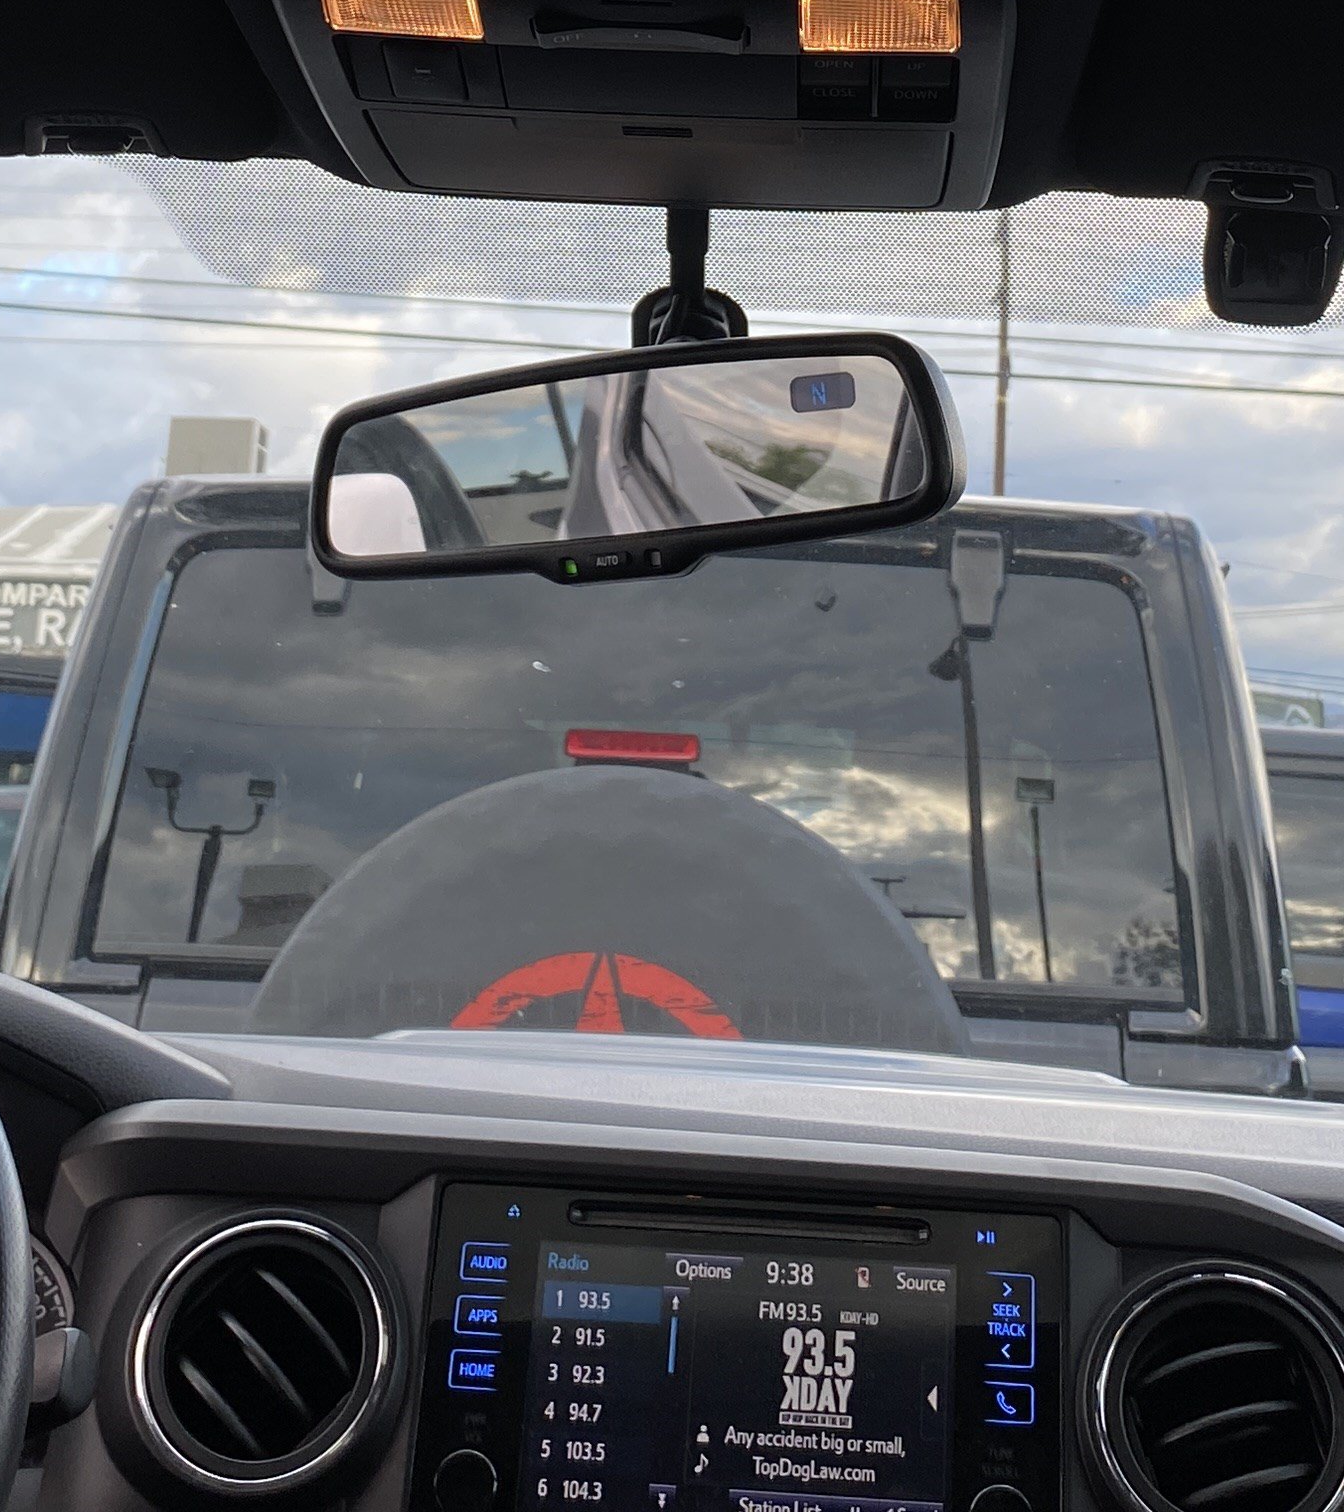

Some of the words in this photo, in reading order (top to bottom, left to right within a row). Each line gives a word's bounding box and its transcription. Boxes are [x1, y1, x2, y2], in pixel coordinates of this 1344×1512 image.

[814, 60, 854, 69] OPEN
[812, 87, 857, 98] CLOSE
[894, 89, 938, 100] DOWN
[596, 554, 619, 567] AUTO
[469, 1255, 508, 1271] AUDIO
[547, 1253, 590, 1270] Radio
[676, 1260, 733, 1282] Options
[765, 1261, 814, 1286] 9:38
[896, 1271, 947, 1293] Source
[556, 1290, 563, 1307] 1
[578, 1292, 611, 1310] 93.5
[992, 1303, 1021, 1317] SEEK
[467, 1309, 499, 1324] APPS
[551, 1326, 562, 1345] 2
[575, 1328, 606, 1347] 91.5
[987, 1322, 1026, 1337] TRACK
[782, 1327, 856, 1378] 93.5
[459, 1362, 496, 1378] HOME
[547, 1364, 559, 1382] 3
[572, 1365, 605, 1385] 92.3
[543, 1401, 555, 1420] 4
[568, 1403, 602, 1423] 94.7
[540, 1439, 552, 1458] 5
[565, 1442, 606, 1462] 103.5
[724, 1425, 755, 1449] Any
[757, 1429, 818, 1449] accident
[821, 1431, 844, 1455] big
[846, 1438, 863, 1452] or
[865, 1436, 906, 1458] small,
[752, 1456, 876, 1483] TopDogLaw.com
[537, 1478, 548, 1497] 6
[562, 1480, 603, 1501] 104.3
